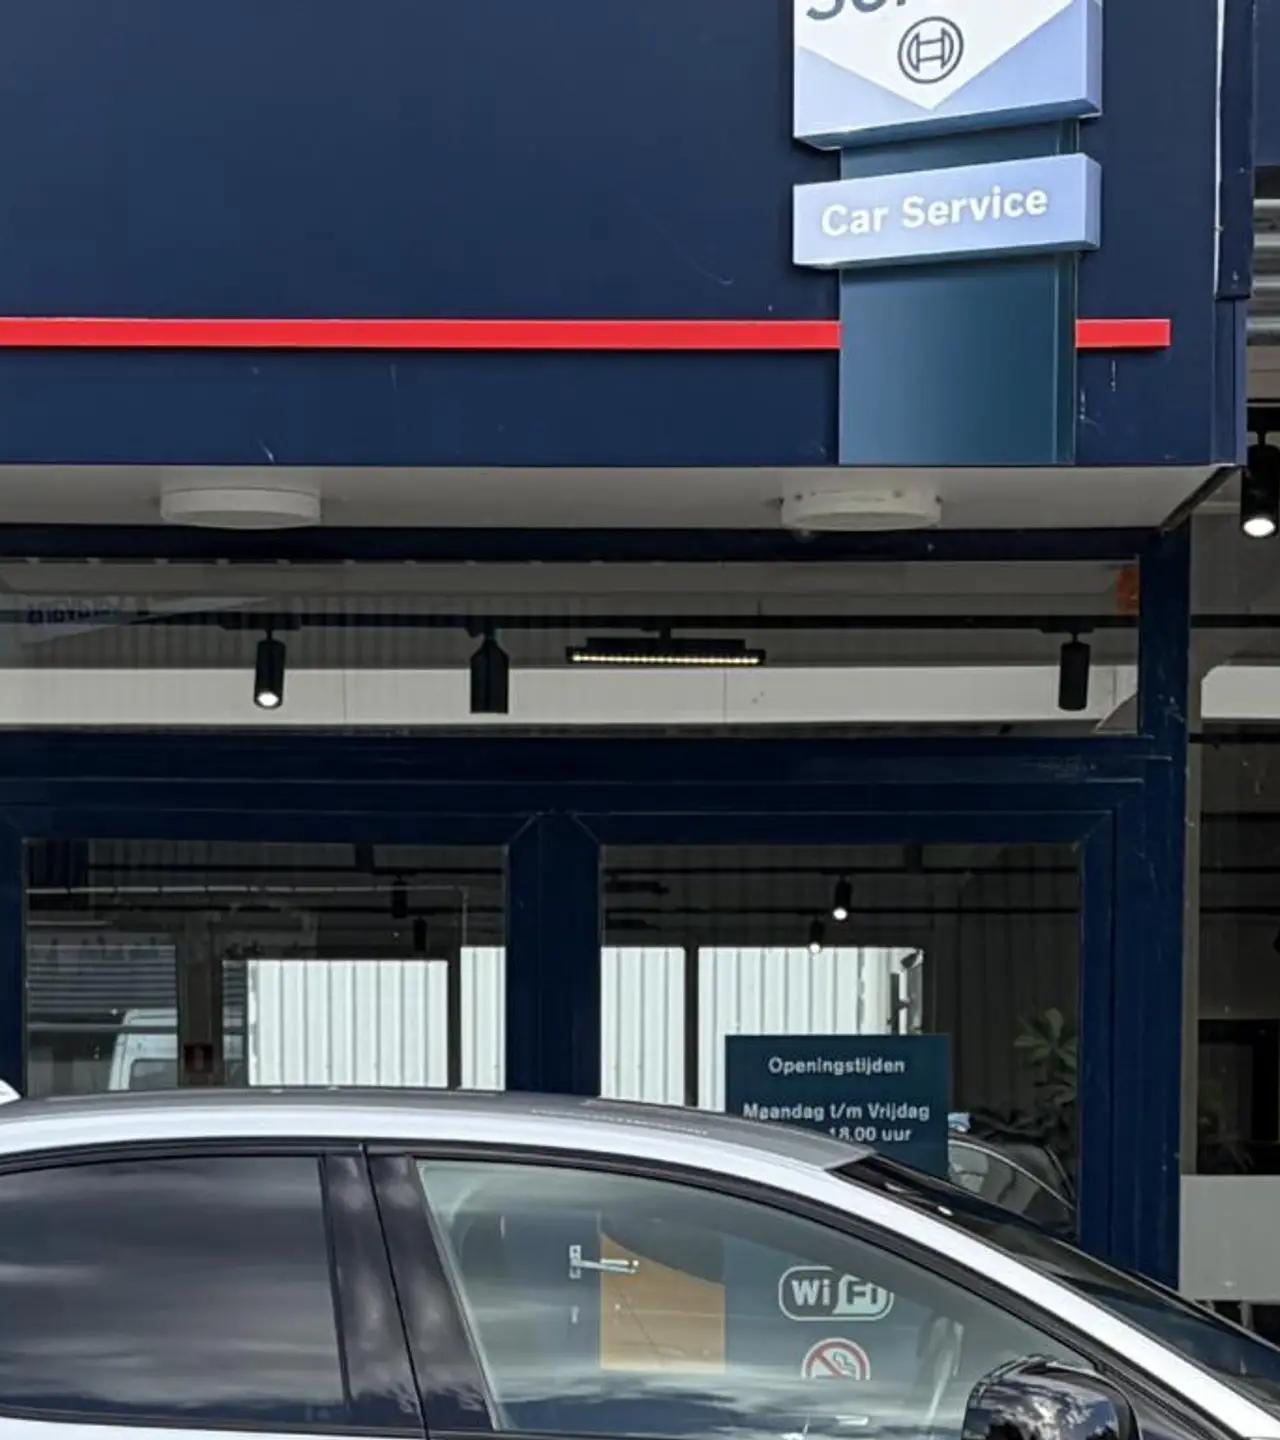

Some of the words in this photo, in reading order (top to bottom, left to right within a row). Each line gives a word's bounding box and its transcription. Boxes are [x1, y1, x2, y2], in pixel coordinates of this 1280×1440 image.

[821, 203, 889, 238] Car
[901, 185, 1049, 230] Service
[768, 1056, 906, 1077] Openingstijden
[742, 1103, 825, 1122] Maandag
[830, 1103, 863, 1120] t/m
[868, 1103, 930, 1122] Vrijdag
[881, 1128, 913, 1142] uur
